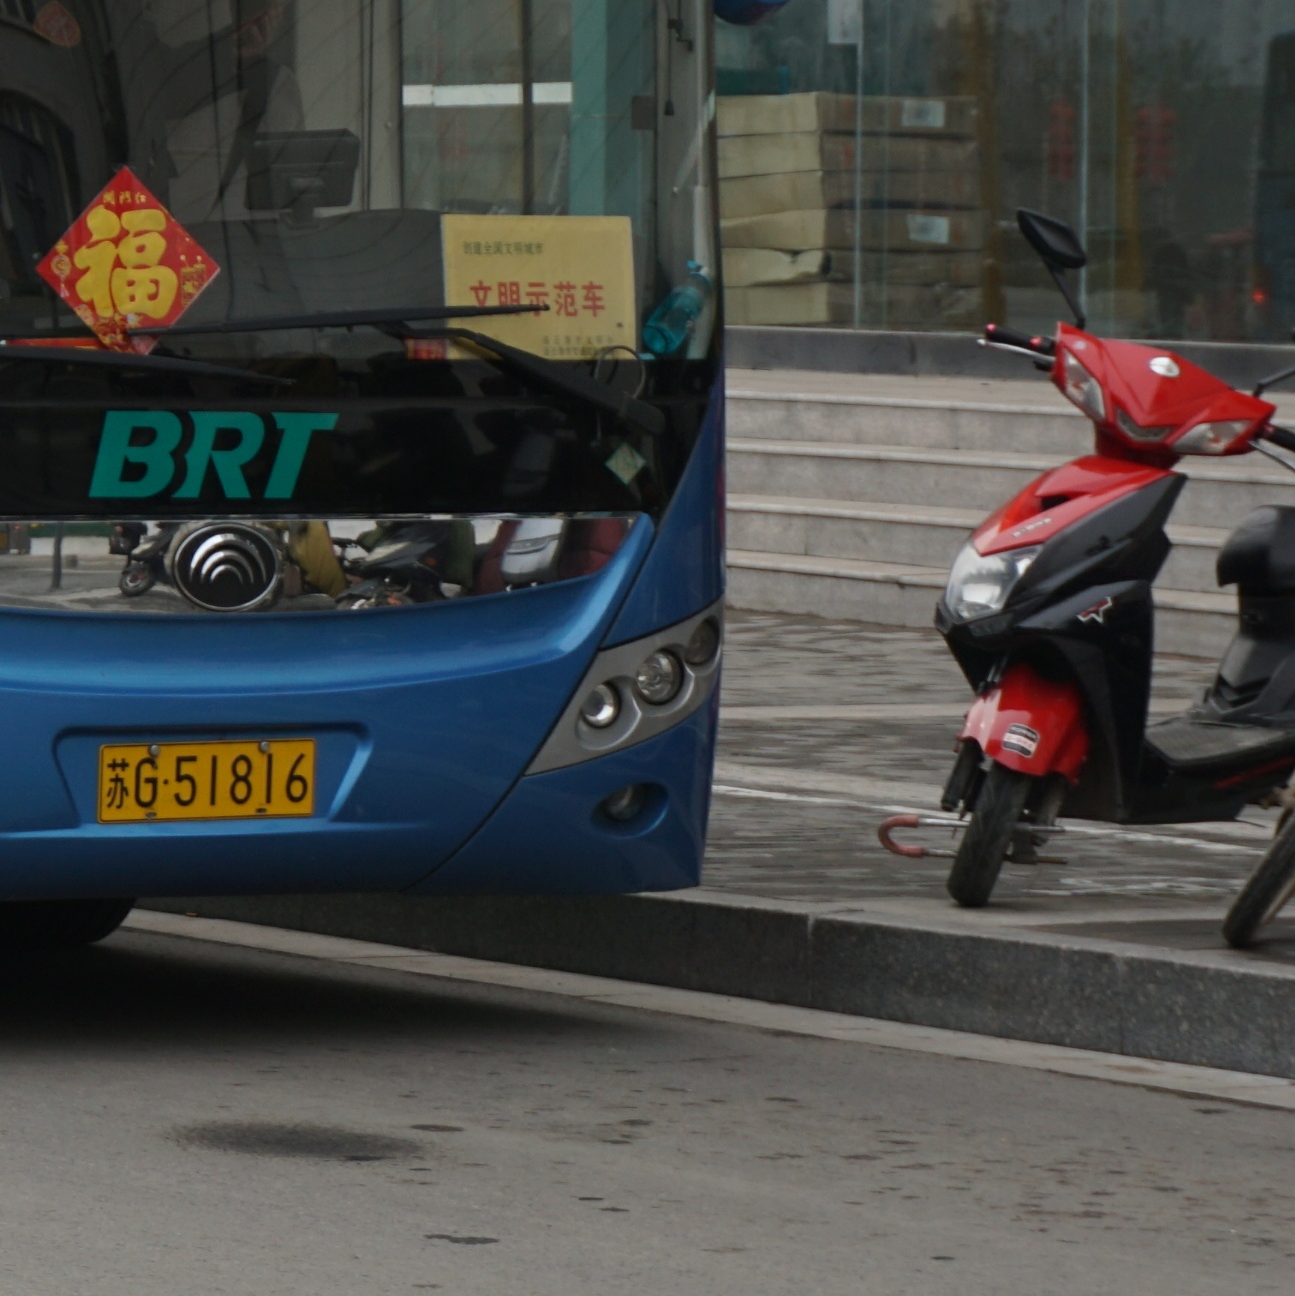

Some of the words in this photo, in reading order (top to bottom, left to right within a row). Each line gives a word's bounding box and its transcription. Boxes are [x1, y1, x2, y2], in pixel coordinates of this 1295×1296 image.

[73, 204, 179, 319] 福
[469, 280, 606, 318] 文明示范车
[88, 409, 341, 500] BRT
